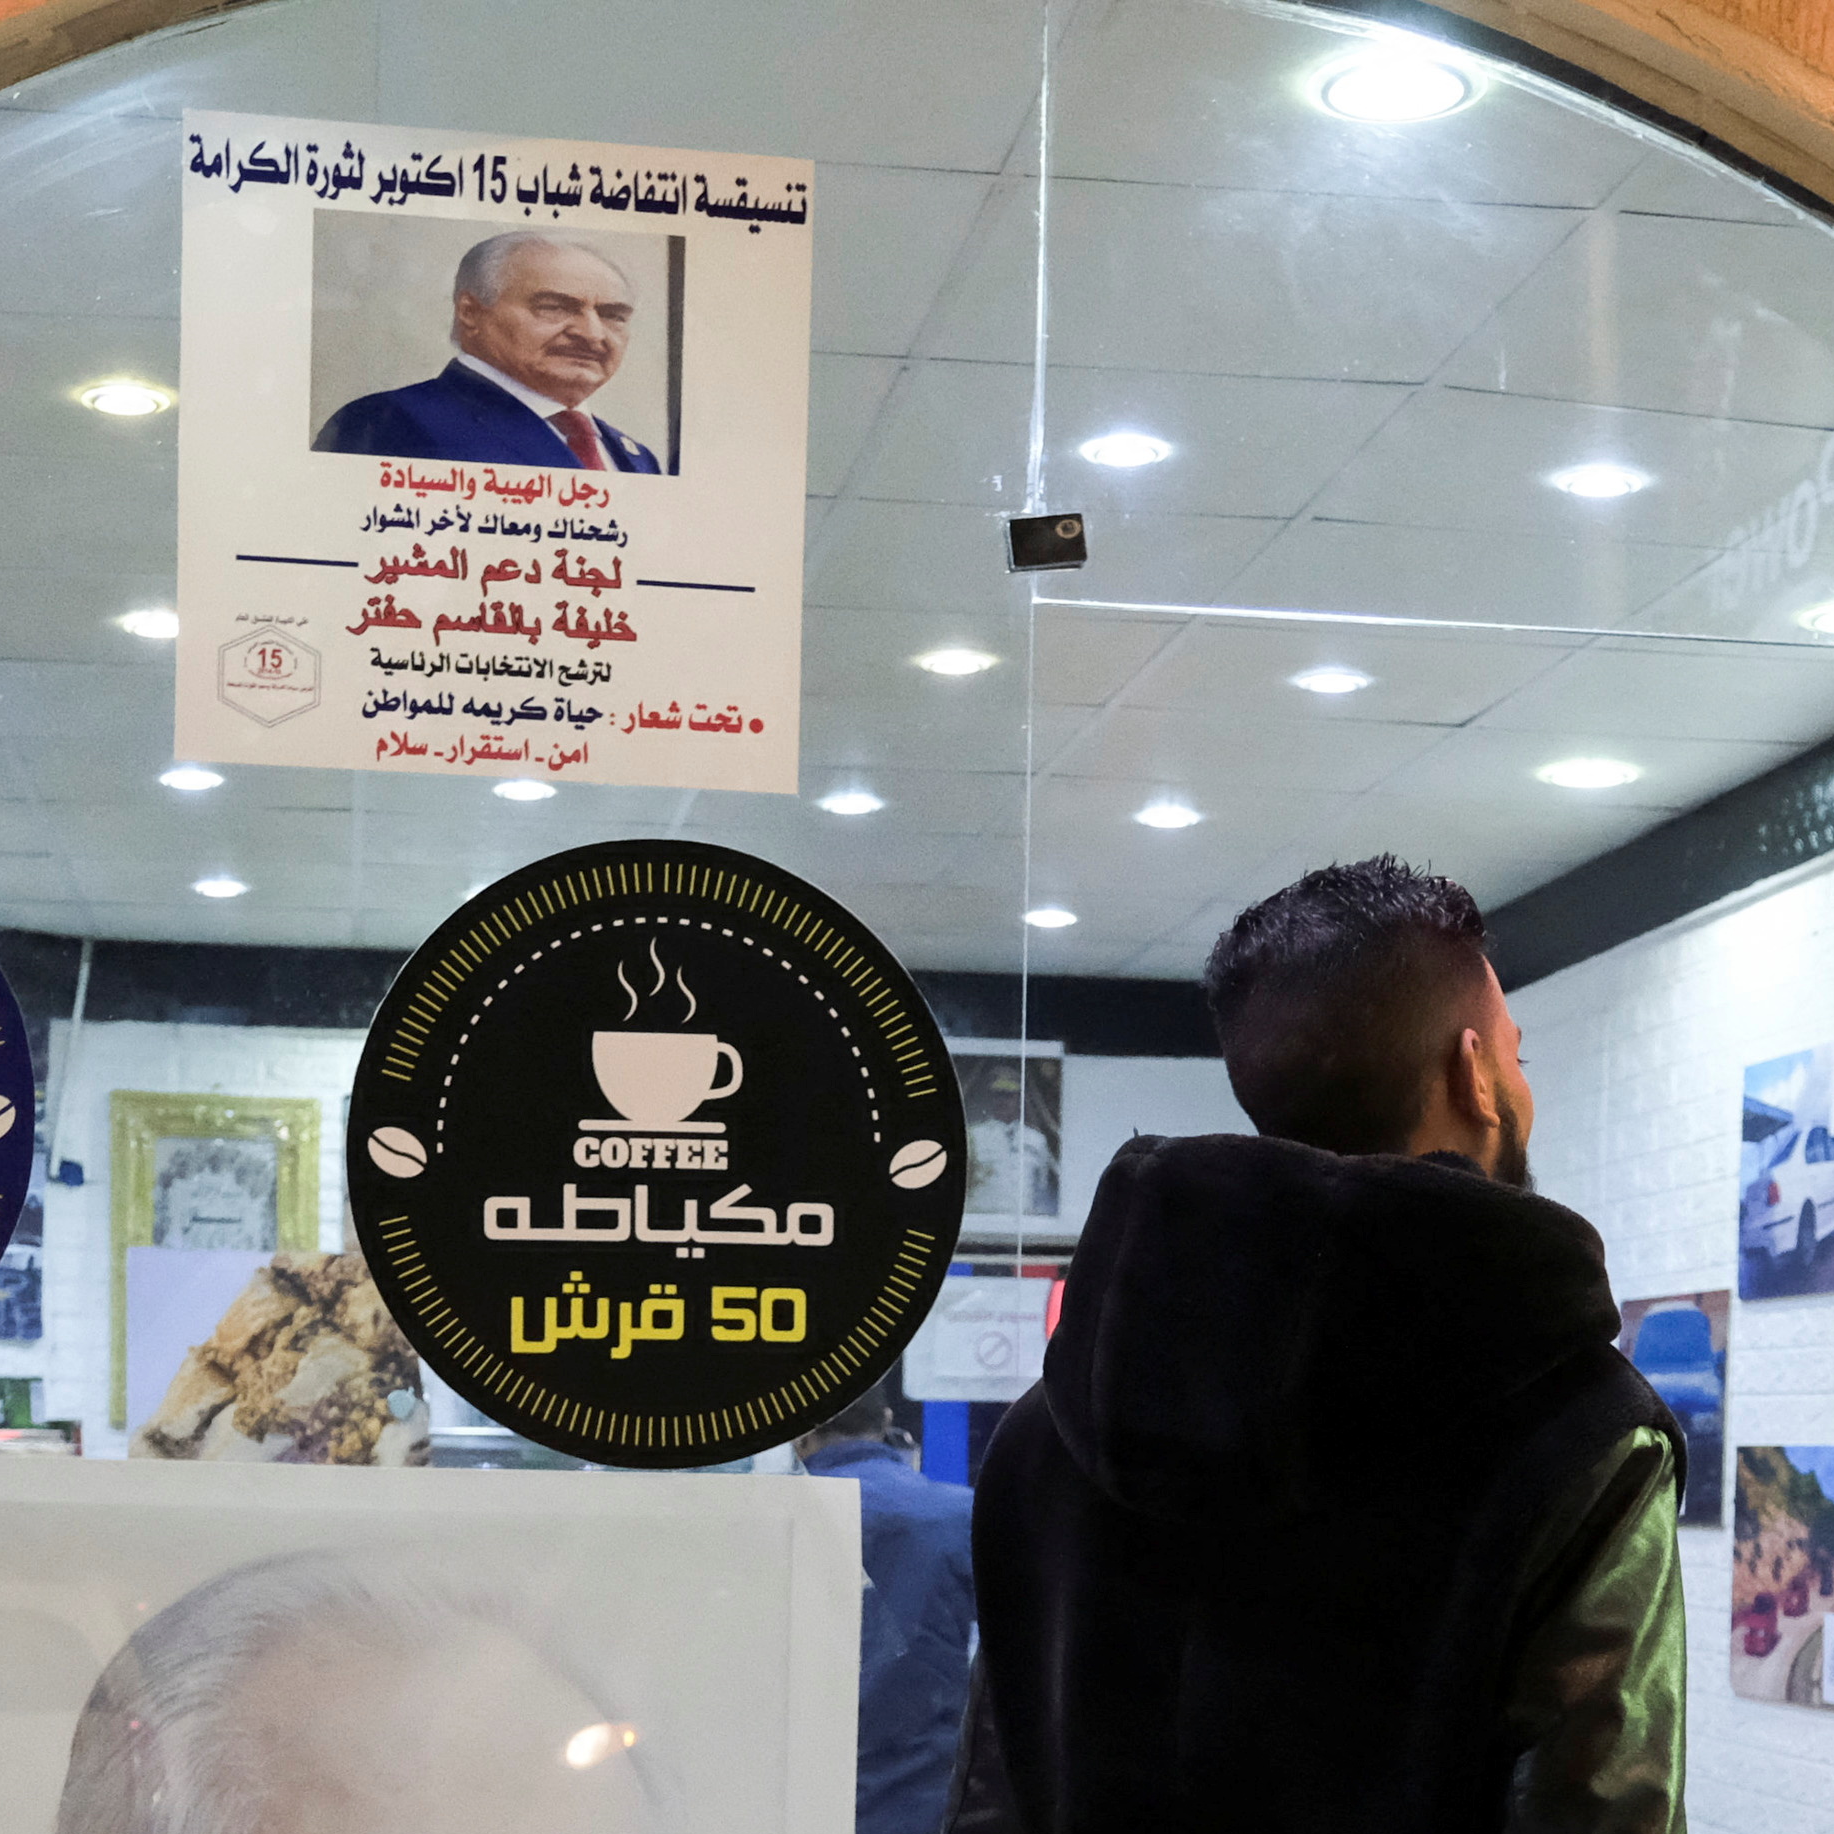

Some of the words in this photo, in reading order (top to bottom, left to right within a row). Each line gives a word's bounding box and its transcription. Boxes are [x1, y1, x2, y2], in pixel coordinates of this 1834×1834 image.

[188, 133, 300, 194] الكرامة
[305, 140, 365, 200] لثورة
[369, 152, 464, 206] اكتوبر
[472, 153, 507, 204] 15
[516, 162, 583, 219] شباب
[589, 165, 686, 214] انتفاضة
[379, 461, 477, 500] والسيادة
[483, 468, 552, 504] الهيبة
[558, 475, 610, 508] رجل
[359, 502, 421, 532] المشوار
[424, 504, 472, 536] لأخر
[477, 512, 542, 543] ومعاك
[546, 517, 628, 548] رشحناك
[363, 542, 468, 585] المشير
[480, 558, 542, 597] دعم
[551, 548, 623, 598] لجنة
[345, 594, 423, 636] حفتر
[432, 601, 542, 647] بالقاسم
[551, 600, 638, 649] خليفة
[257, 647, 284, 669] 15
[454, 654, 554, 683] الانتخابات
[557, 659, 612, 687] لترشح
[361, 689, 454, 720] للمواطن
[461, 697, 548, 727] كريمه
[553, 699, 603, 732] حياة
[688, 703, 743, 734] تحت
[375, 730, 429, 763] سلام
[448, 734, 530, 767] استقرار
[547, 741, 590, 771] امن
[572, 1136, 730, 1171] COFFEE
[483, 1182, 835, 1260] مكياطه
[510, 1270, 686, 1360] قرش
[711, 1285, 808, 1343] 50
